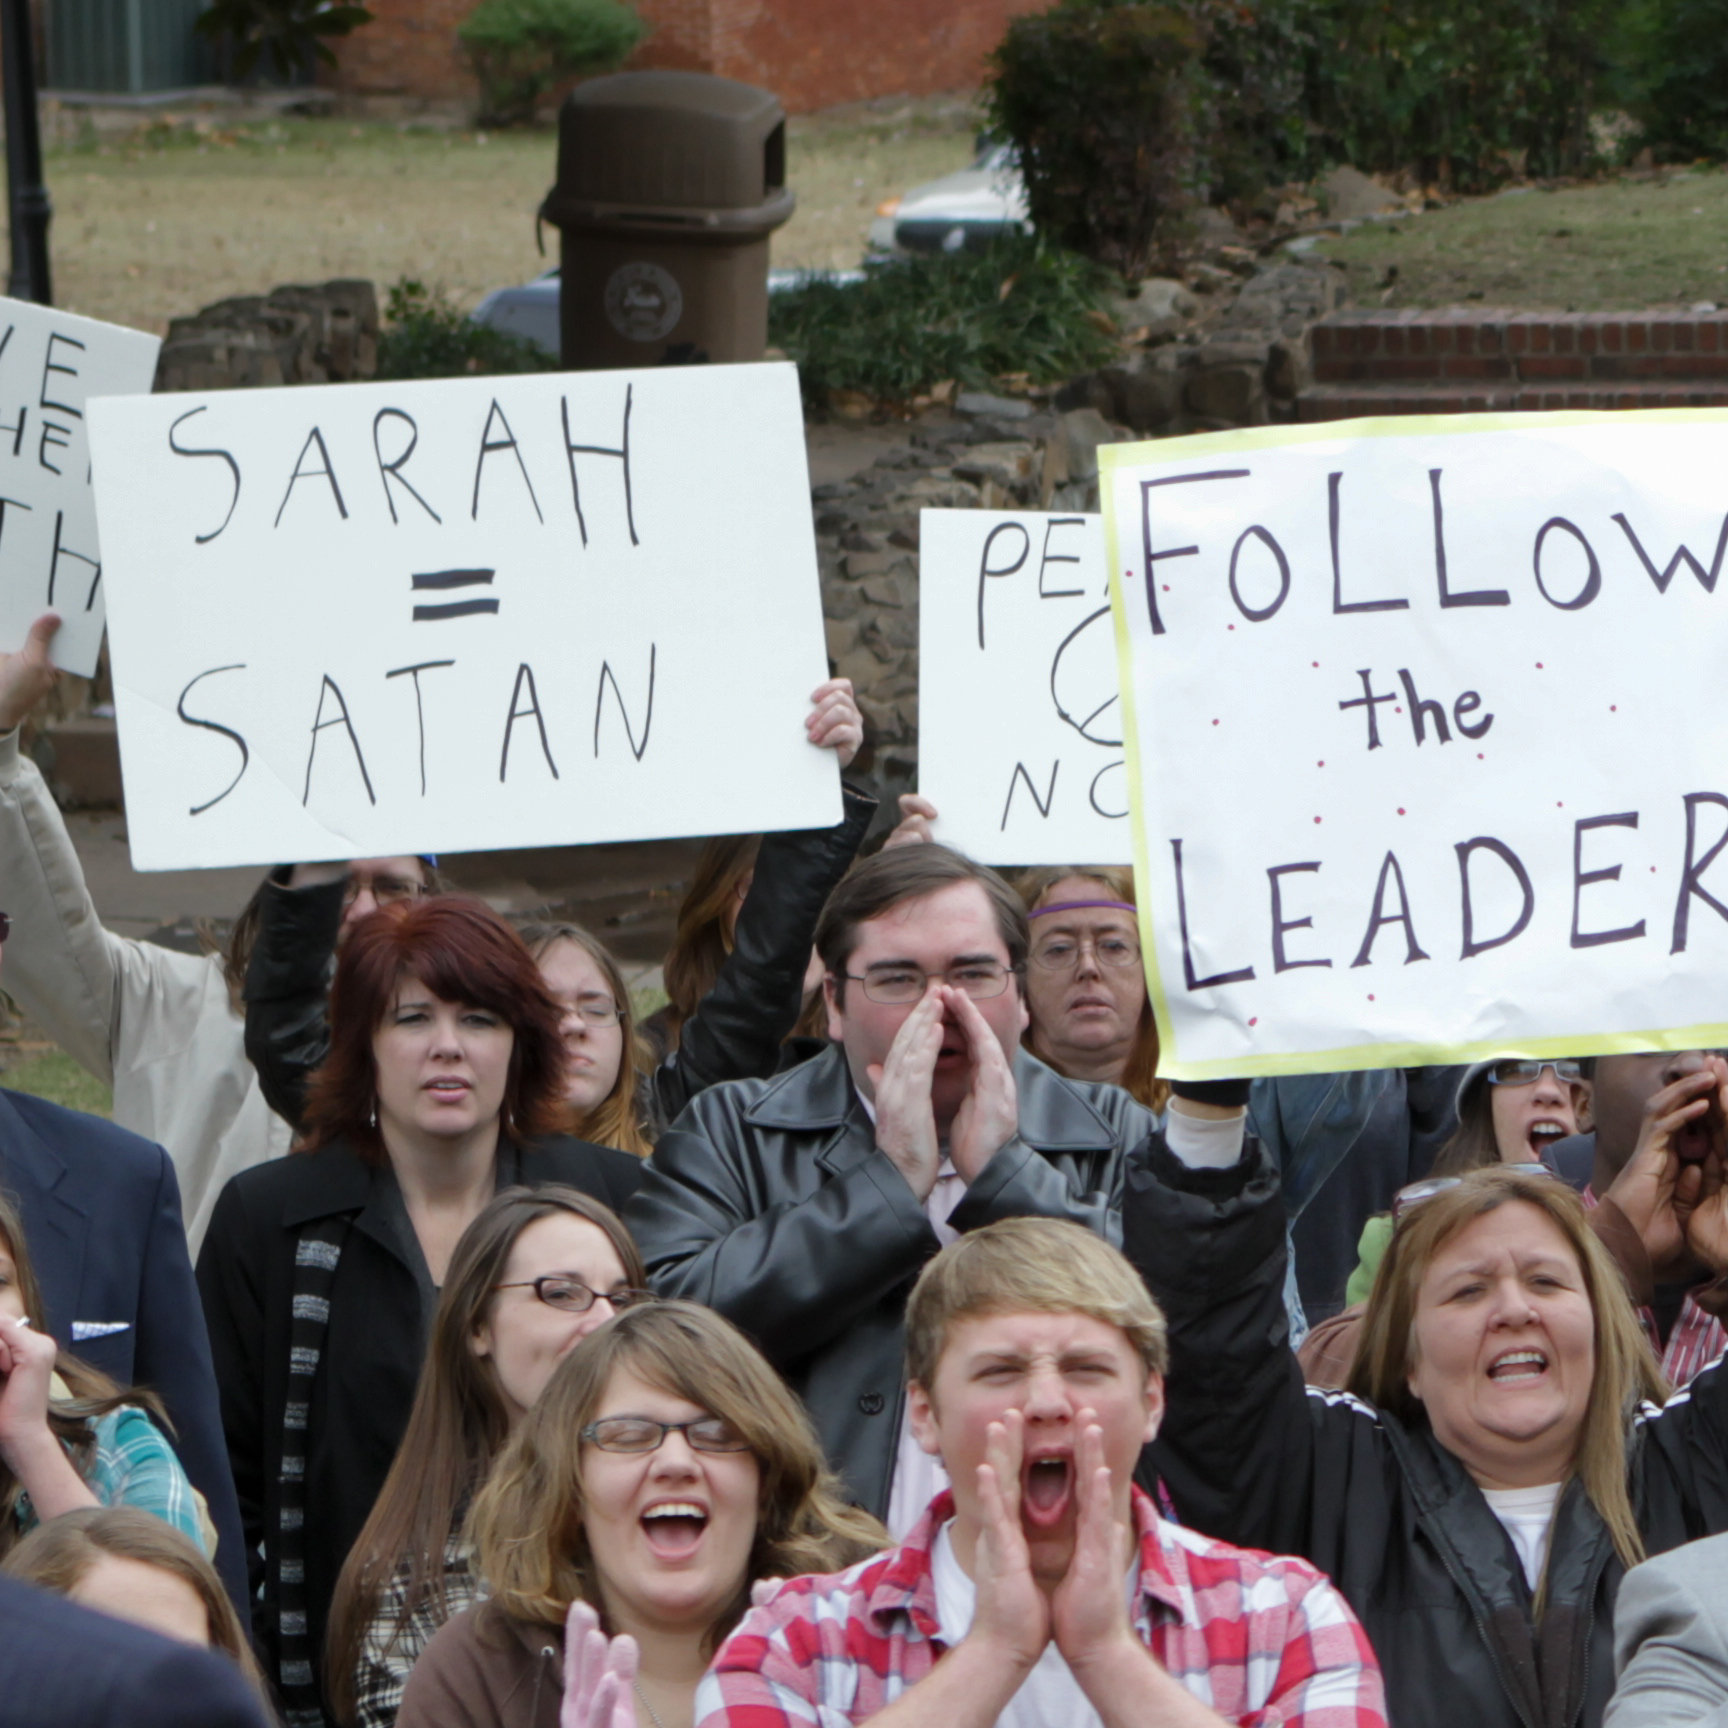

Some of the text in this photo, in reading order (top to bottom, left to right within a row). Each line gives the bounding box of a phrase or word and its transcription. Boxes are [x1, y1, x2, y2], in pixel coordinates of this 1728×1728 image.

[0, 326, 86, 420] E
[169, 382, 640, 549] SARAH
[978, 519, 1110, 650] PE
[176, 642, 656, 815] SATAN
[1338, 668, 1494, 750] the
